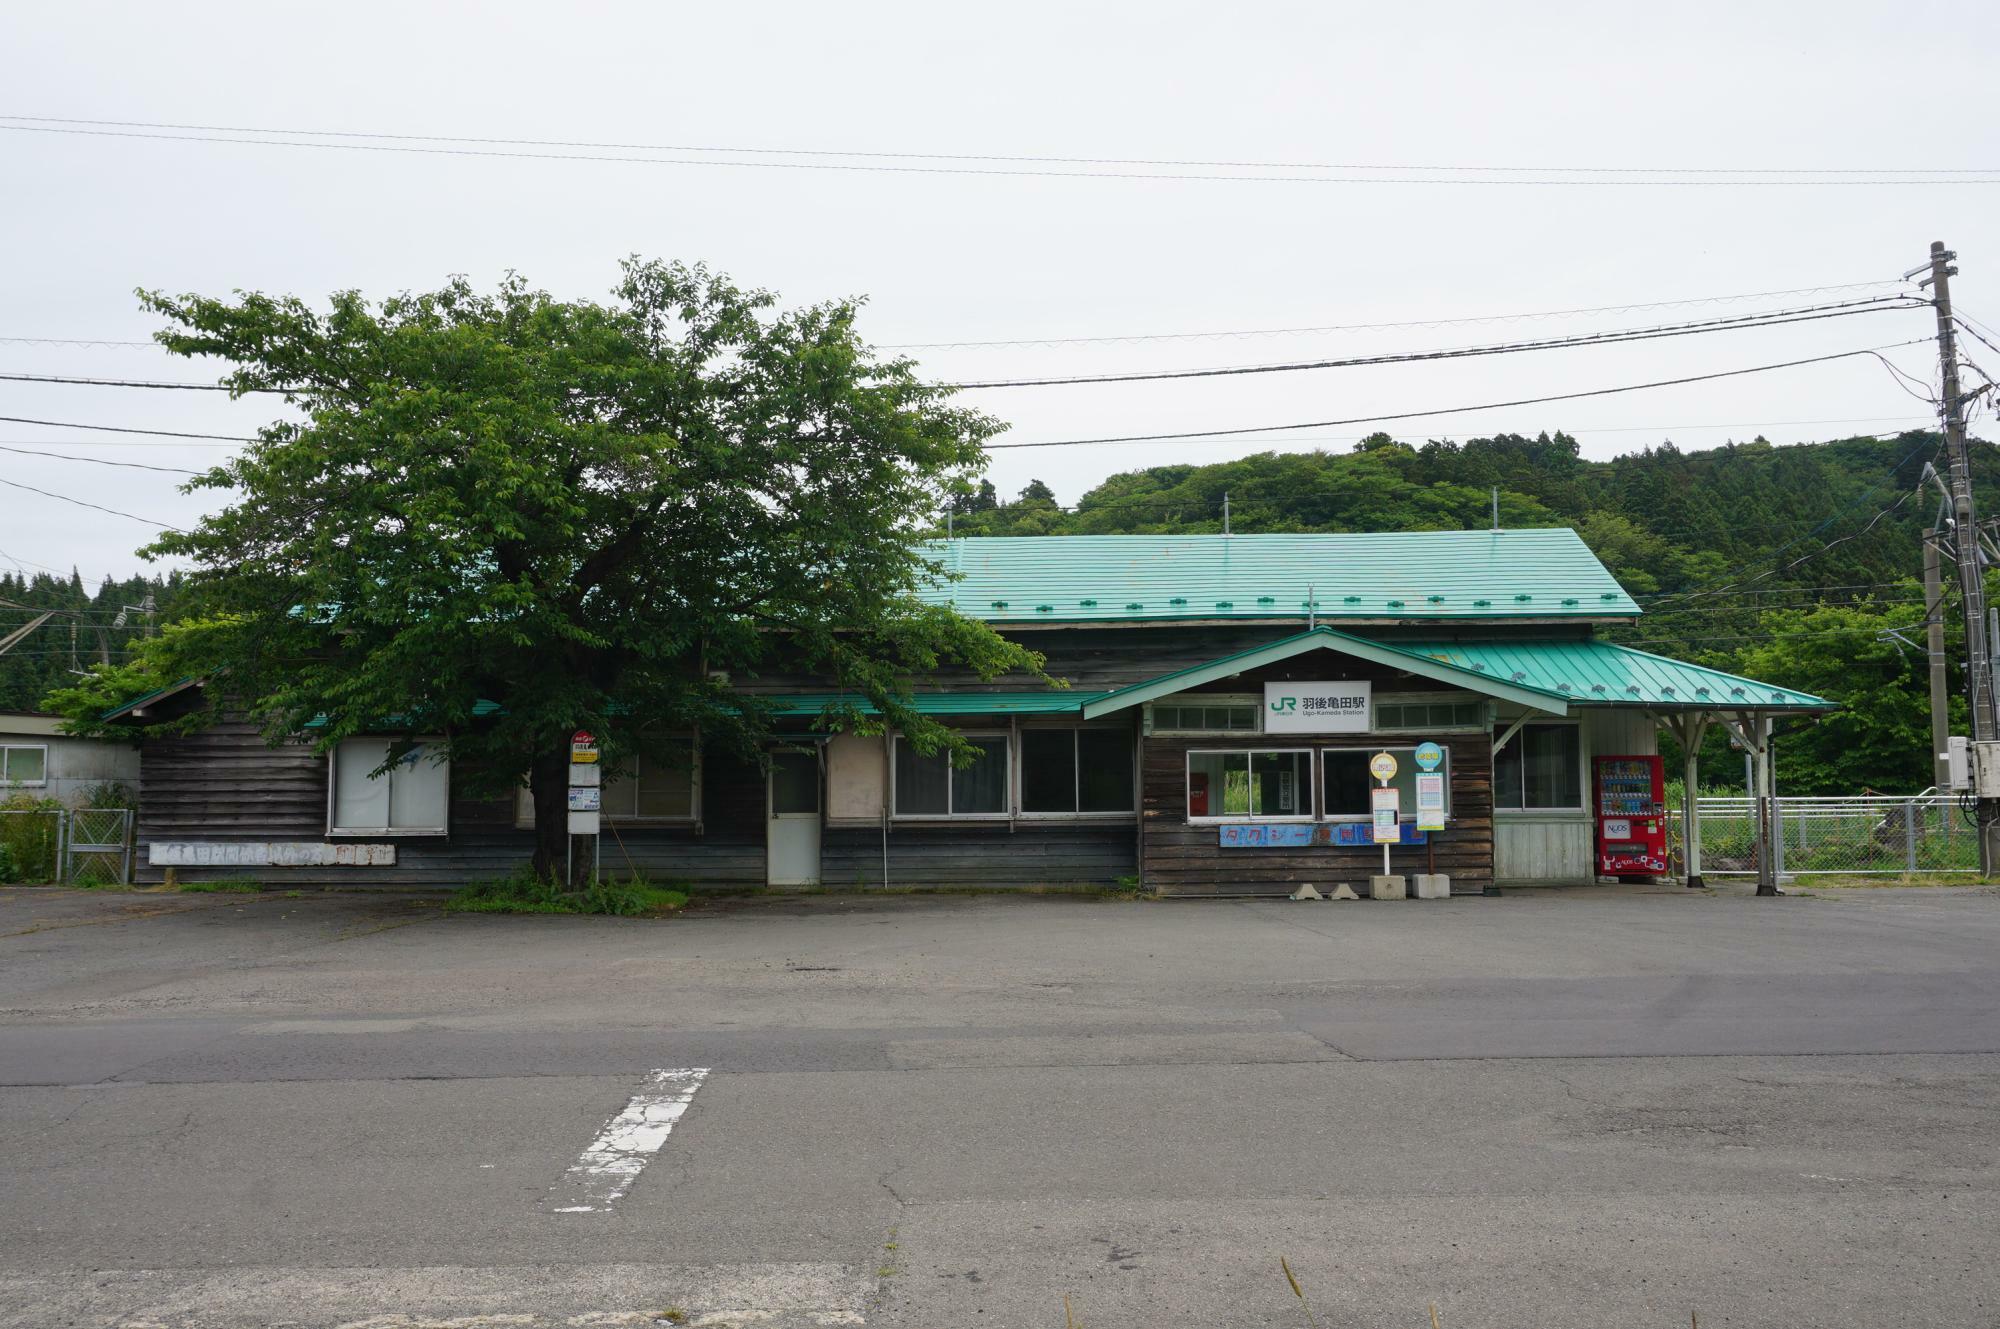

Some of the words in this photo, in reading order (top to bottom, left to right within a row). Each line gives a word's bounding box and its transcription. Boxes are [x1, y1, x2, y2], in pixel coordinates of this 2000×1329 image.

[1270, 696, 1297, 711] JR
[1302, 696, 1365, 710] 羽後亀田駅
